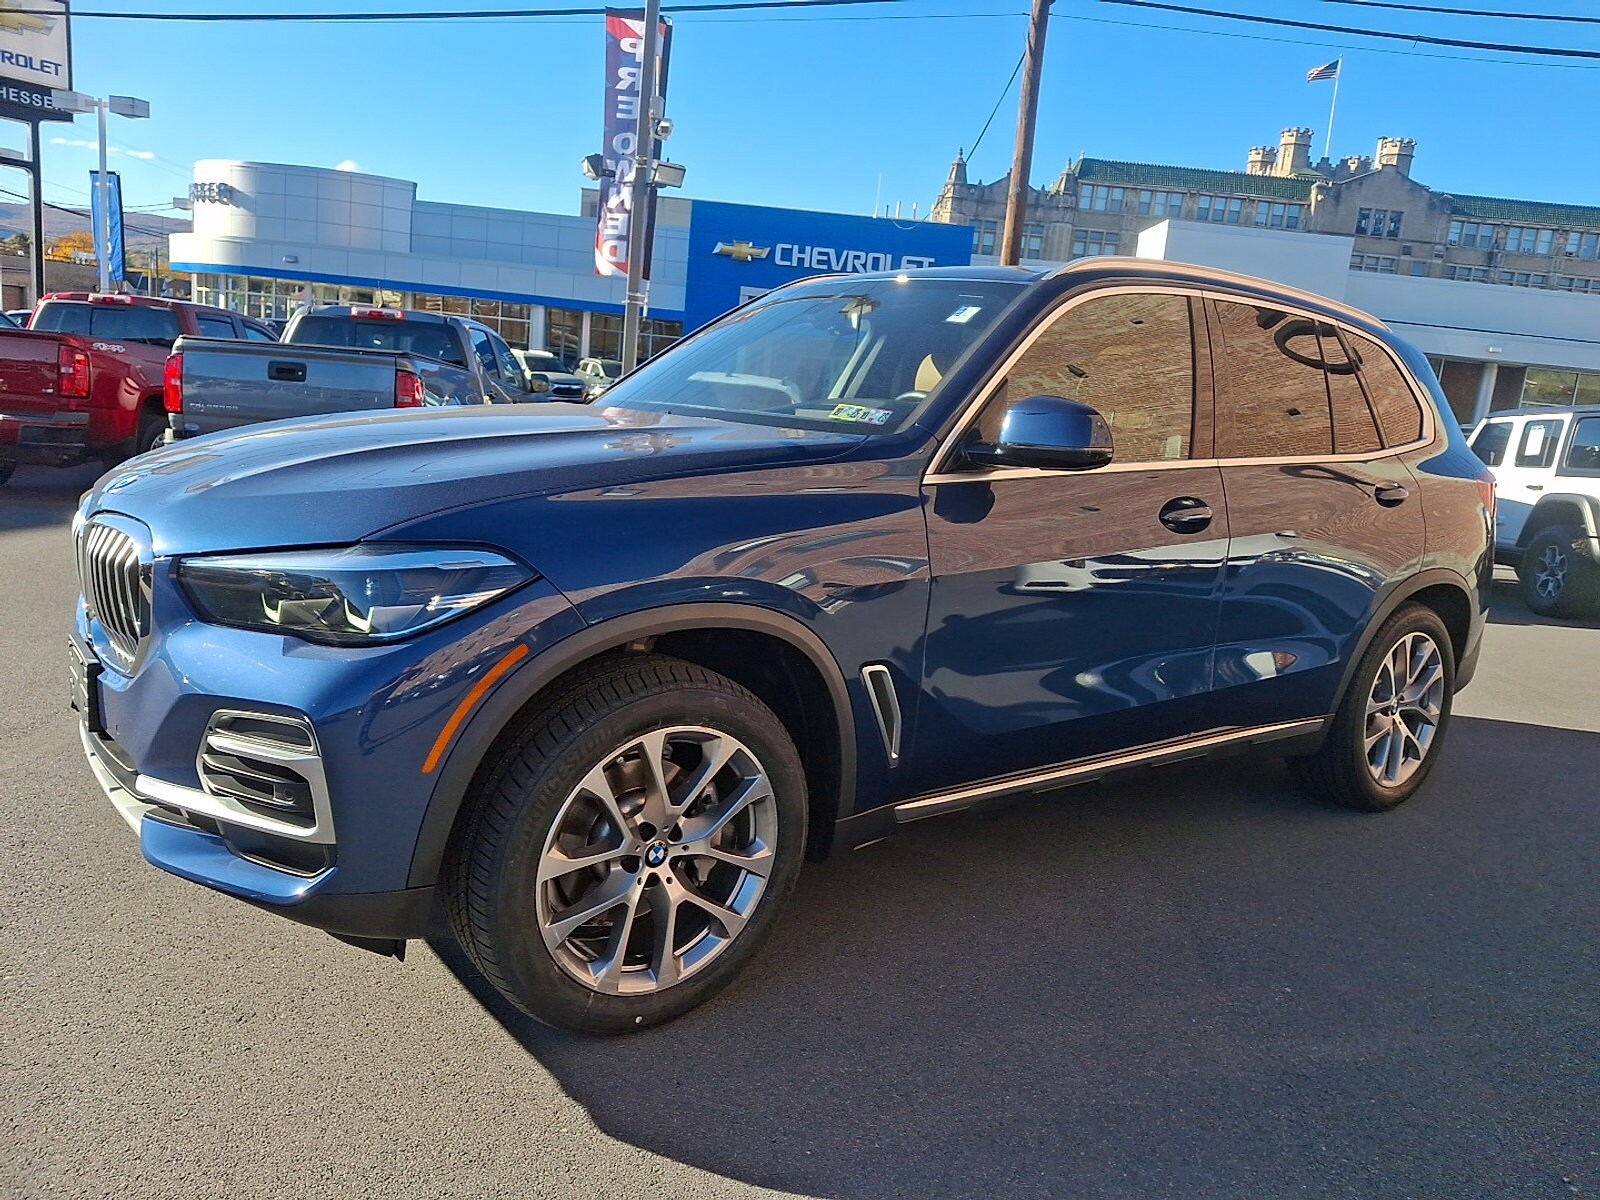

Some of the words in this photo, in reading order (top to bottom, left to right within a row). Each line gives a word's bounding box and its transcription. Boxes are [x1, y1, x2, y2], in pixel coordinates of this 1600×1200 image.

[0, 49, 62, 76] ROLET
[0, 86, 65, 111] HESSE
[775, 243, 935, 273] CHEVROLET
